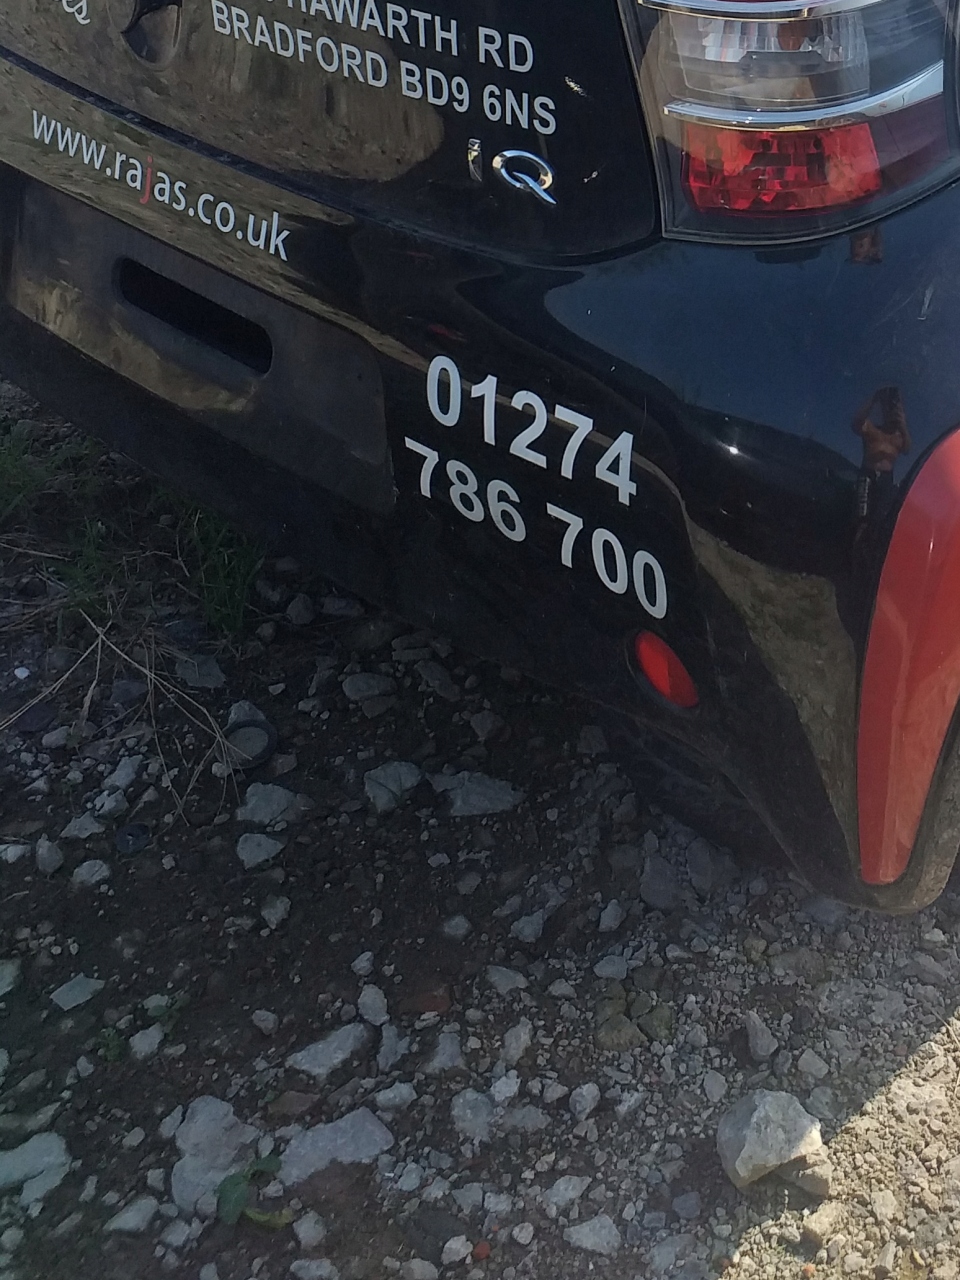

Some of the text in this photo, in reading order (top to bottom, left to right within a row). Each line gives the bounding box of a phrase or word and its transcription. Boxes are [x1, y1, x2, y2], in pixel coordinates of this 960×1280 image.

[211, 0, 557, 135] BRADFORD BD9 6NS
[478, 26, 534, 73] RD
[32, 109, 291, 261] www.rajas.co.uk
[426, 355, 637, 506] 01274
[405, 436, 668, 619] 786 700
